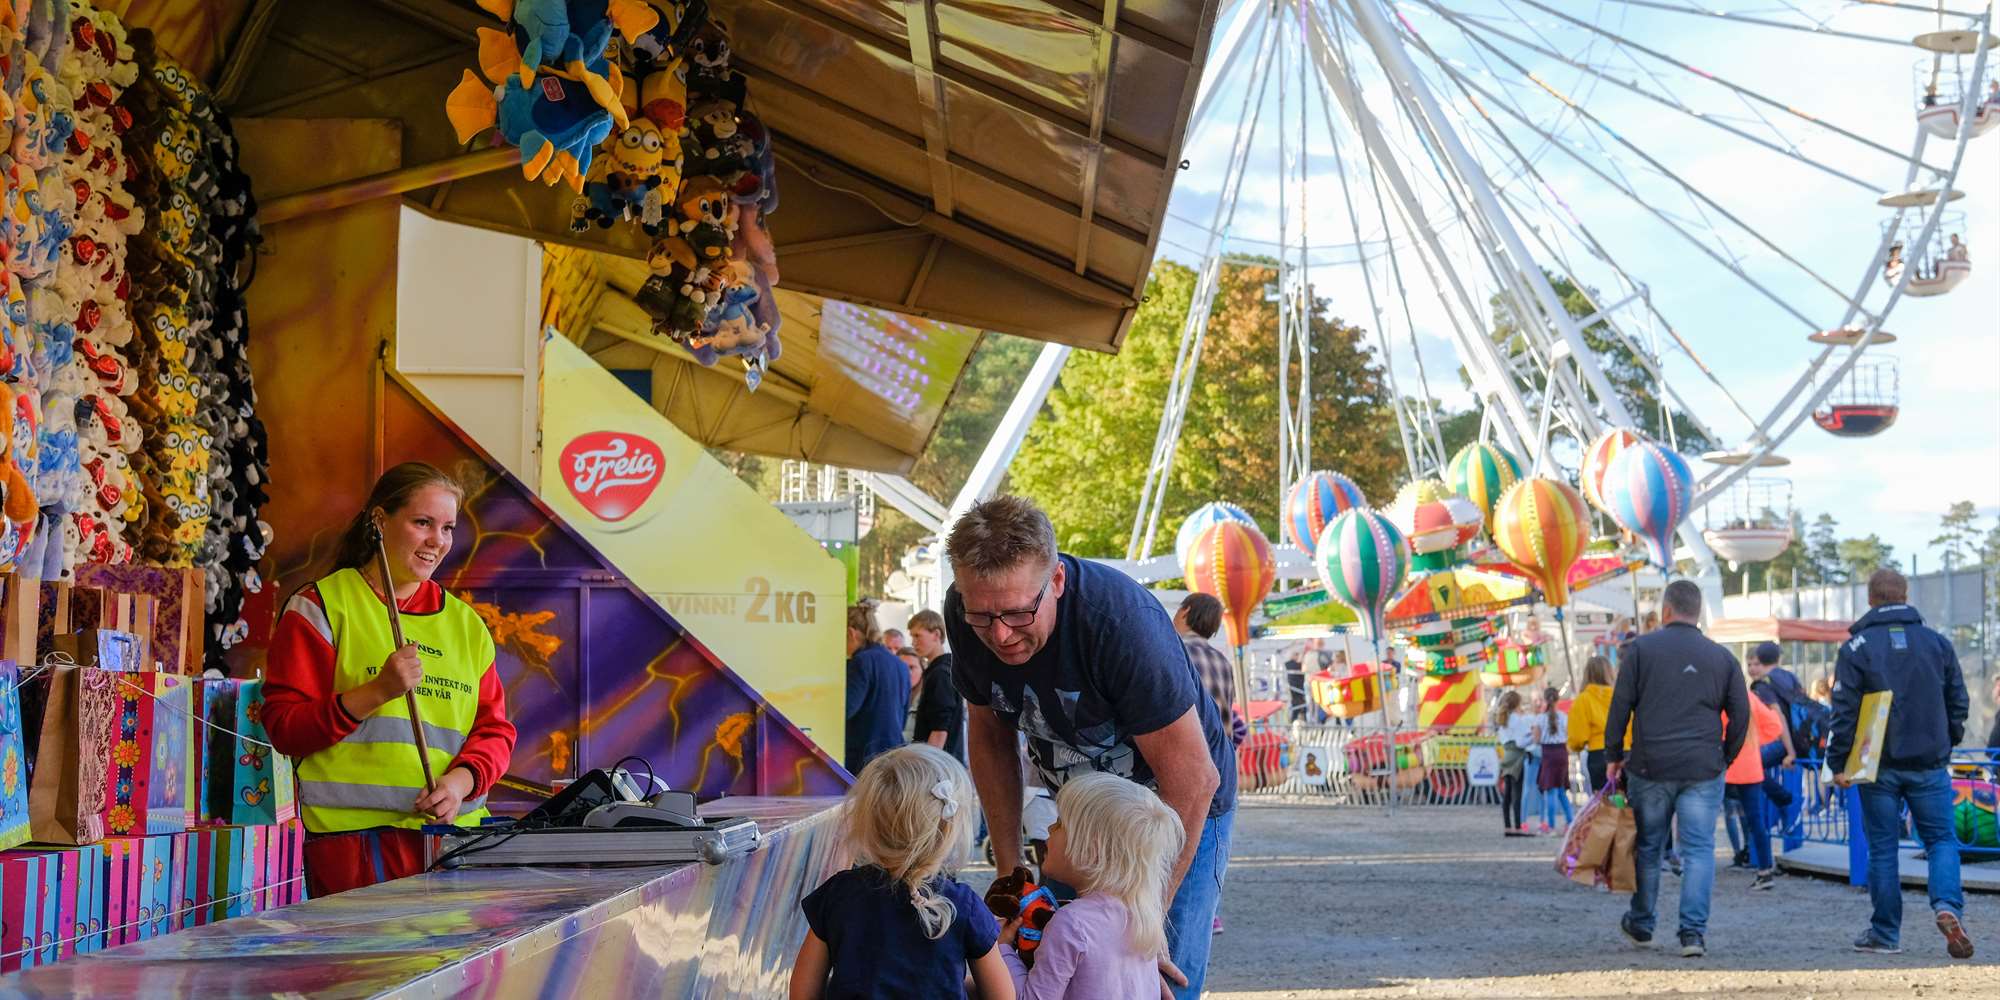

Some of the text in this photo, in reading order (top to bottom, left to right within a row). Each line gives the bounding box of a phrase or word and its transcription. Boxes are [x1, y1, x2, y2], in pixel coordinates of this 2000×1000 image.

[572, 438, 657, 497] Freia
[666, 576, 816, 624] VINN! 2 KG
[425, 675, 460, 690] INNTEKT
